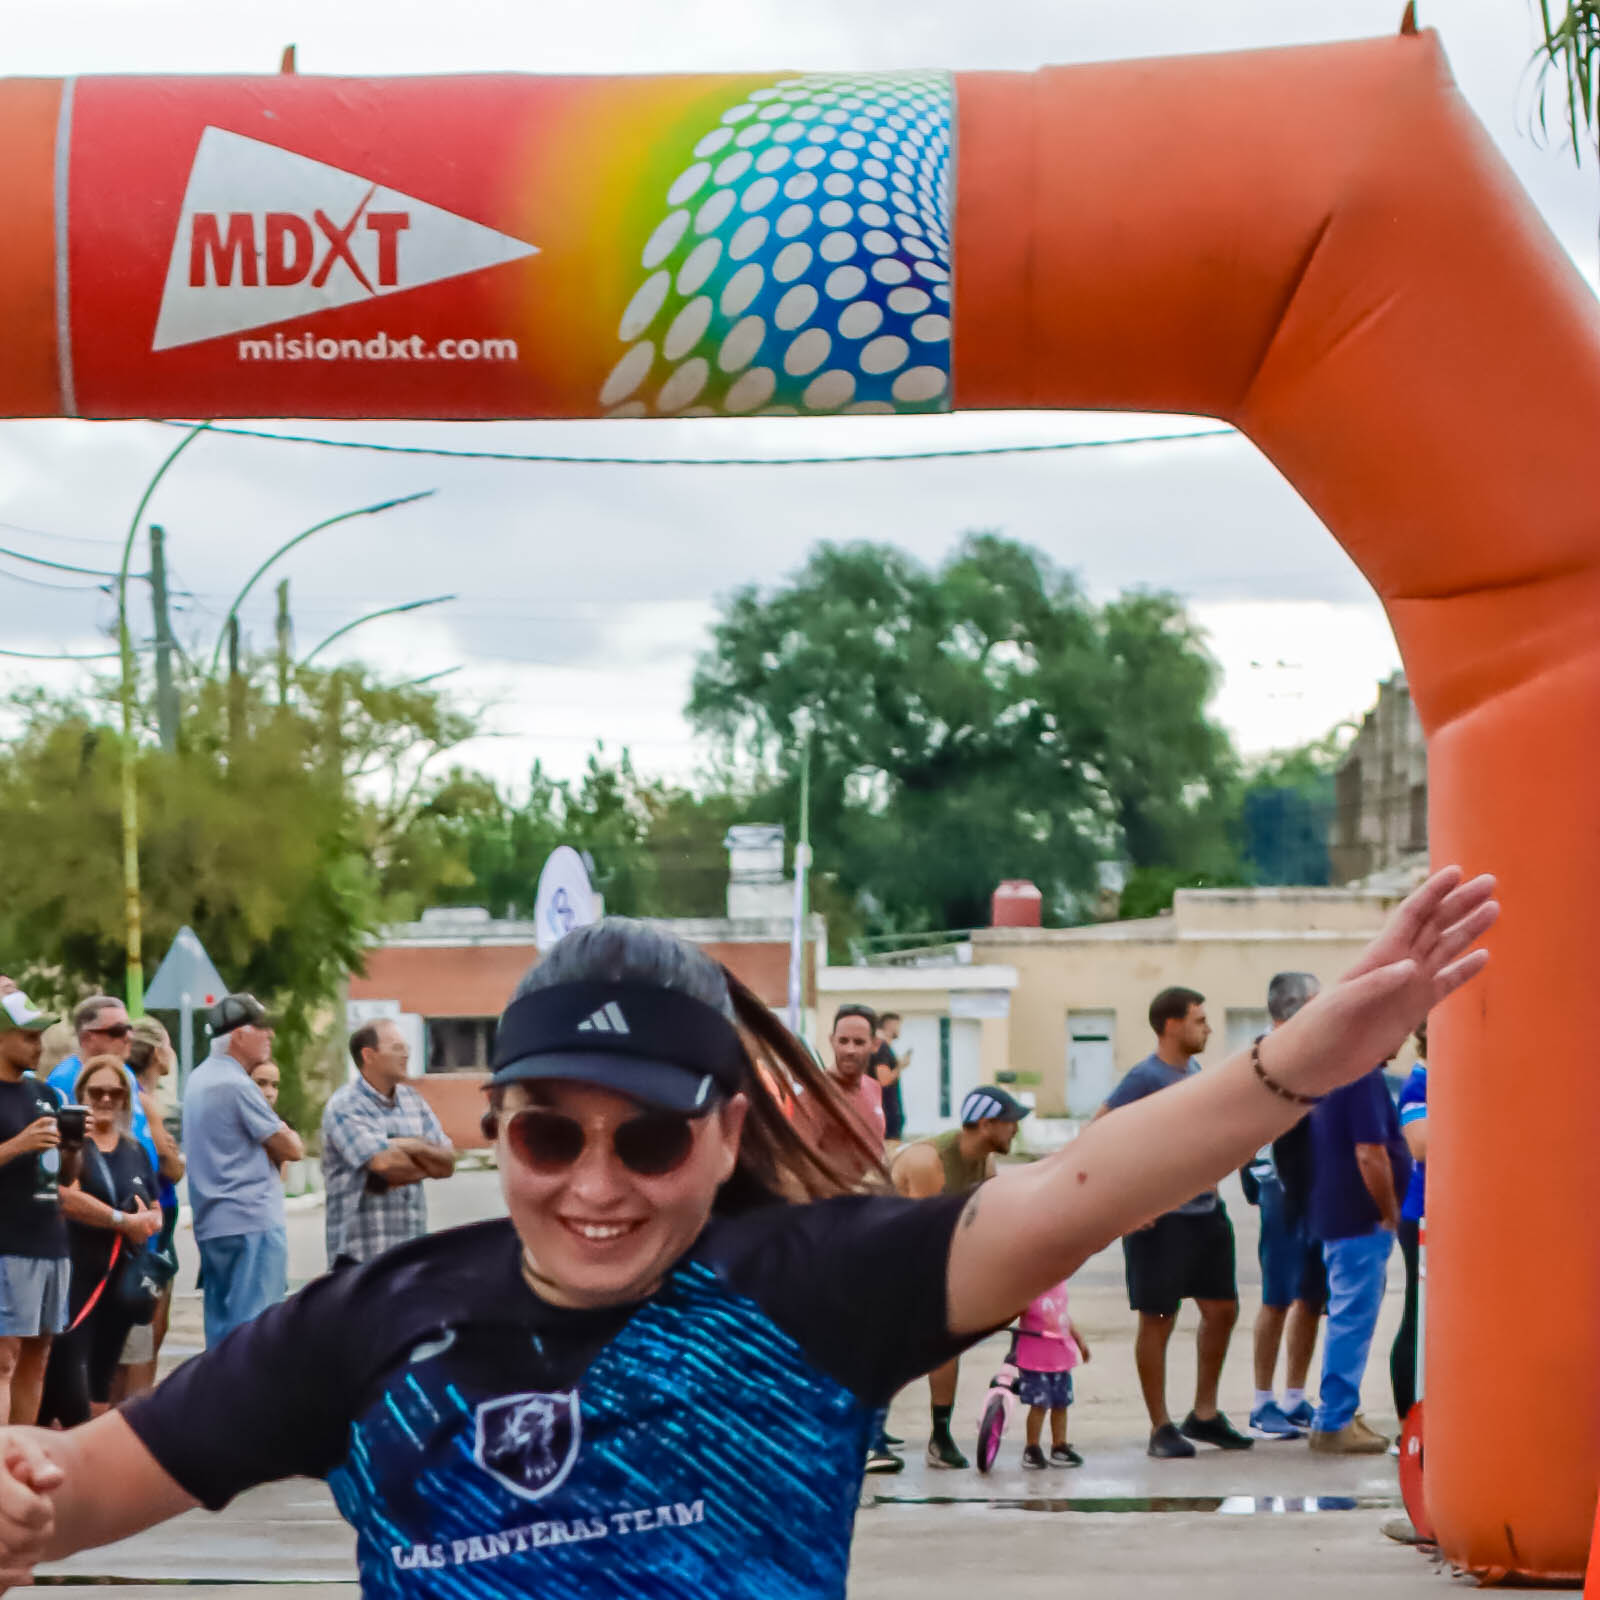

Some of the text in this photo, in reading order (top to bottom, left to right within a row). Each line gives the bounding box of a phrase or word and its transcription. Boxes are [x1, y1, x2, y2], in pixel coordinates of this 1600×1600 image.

[188, 183, 410, 296] MDXT
[238, 332, 519, 362] misiondxt.com
[391, 1499, 705, 1570] LAS PANTERAS TEAM
